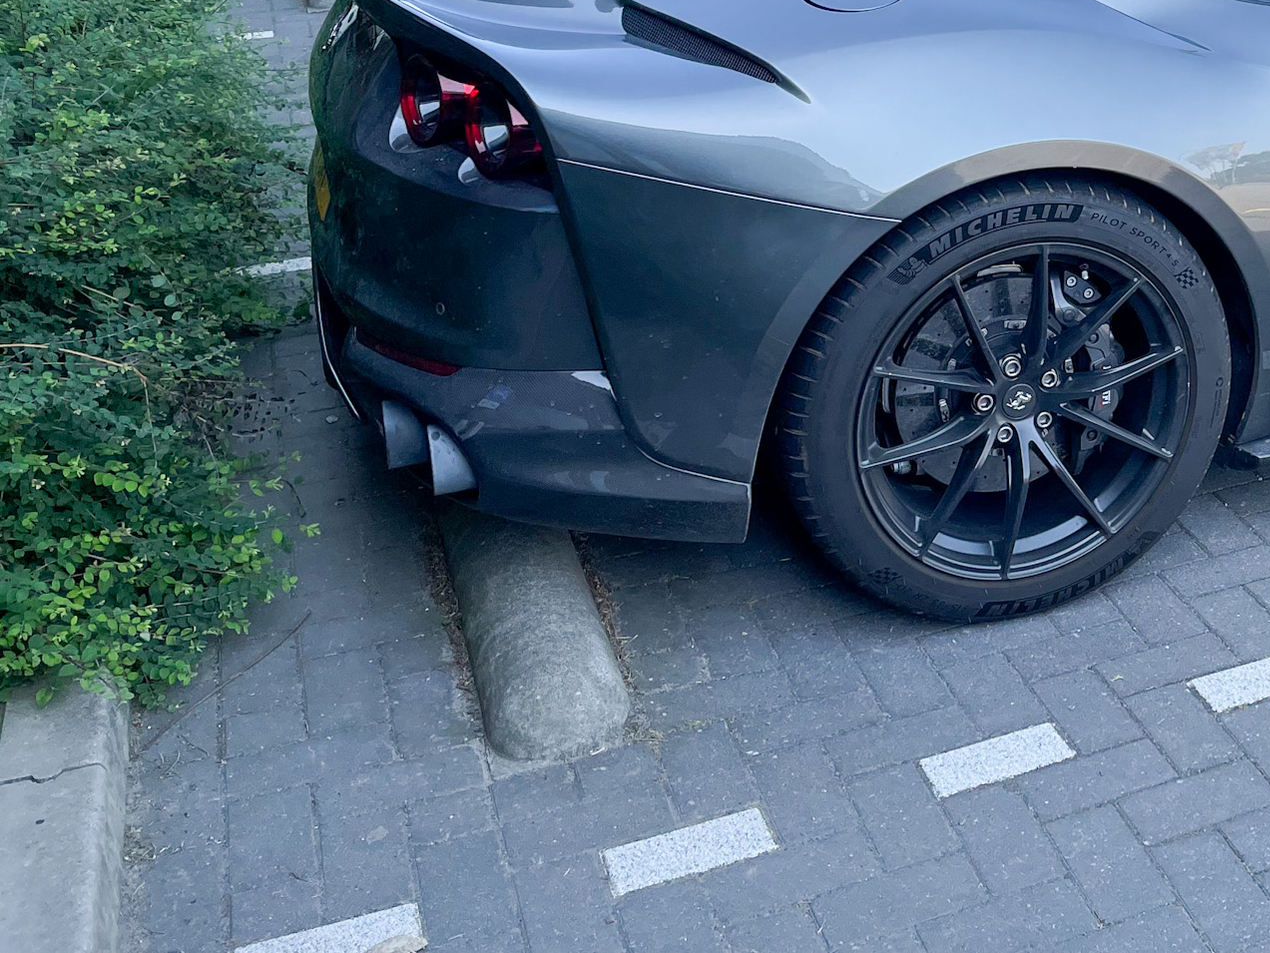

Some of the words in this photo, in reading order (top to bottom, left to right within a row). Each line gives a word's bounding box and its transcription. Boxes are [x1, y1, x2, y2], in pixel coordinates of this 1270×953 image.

[929, 204, 1074, 259] MICHELIN
[1090, 212, 1127, 230] PILOT
[1129, 226, 1167, 255] SPORT
